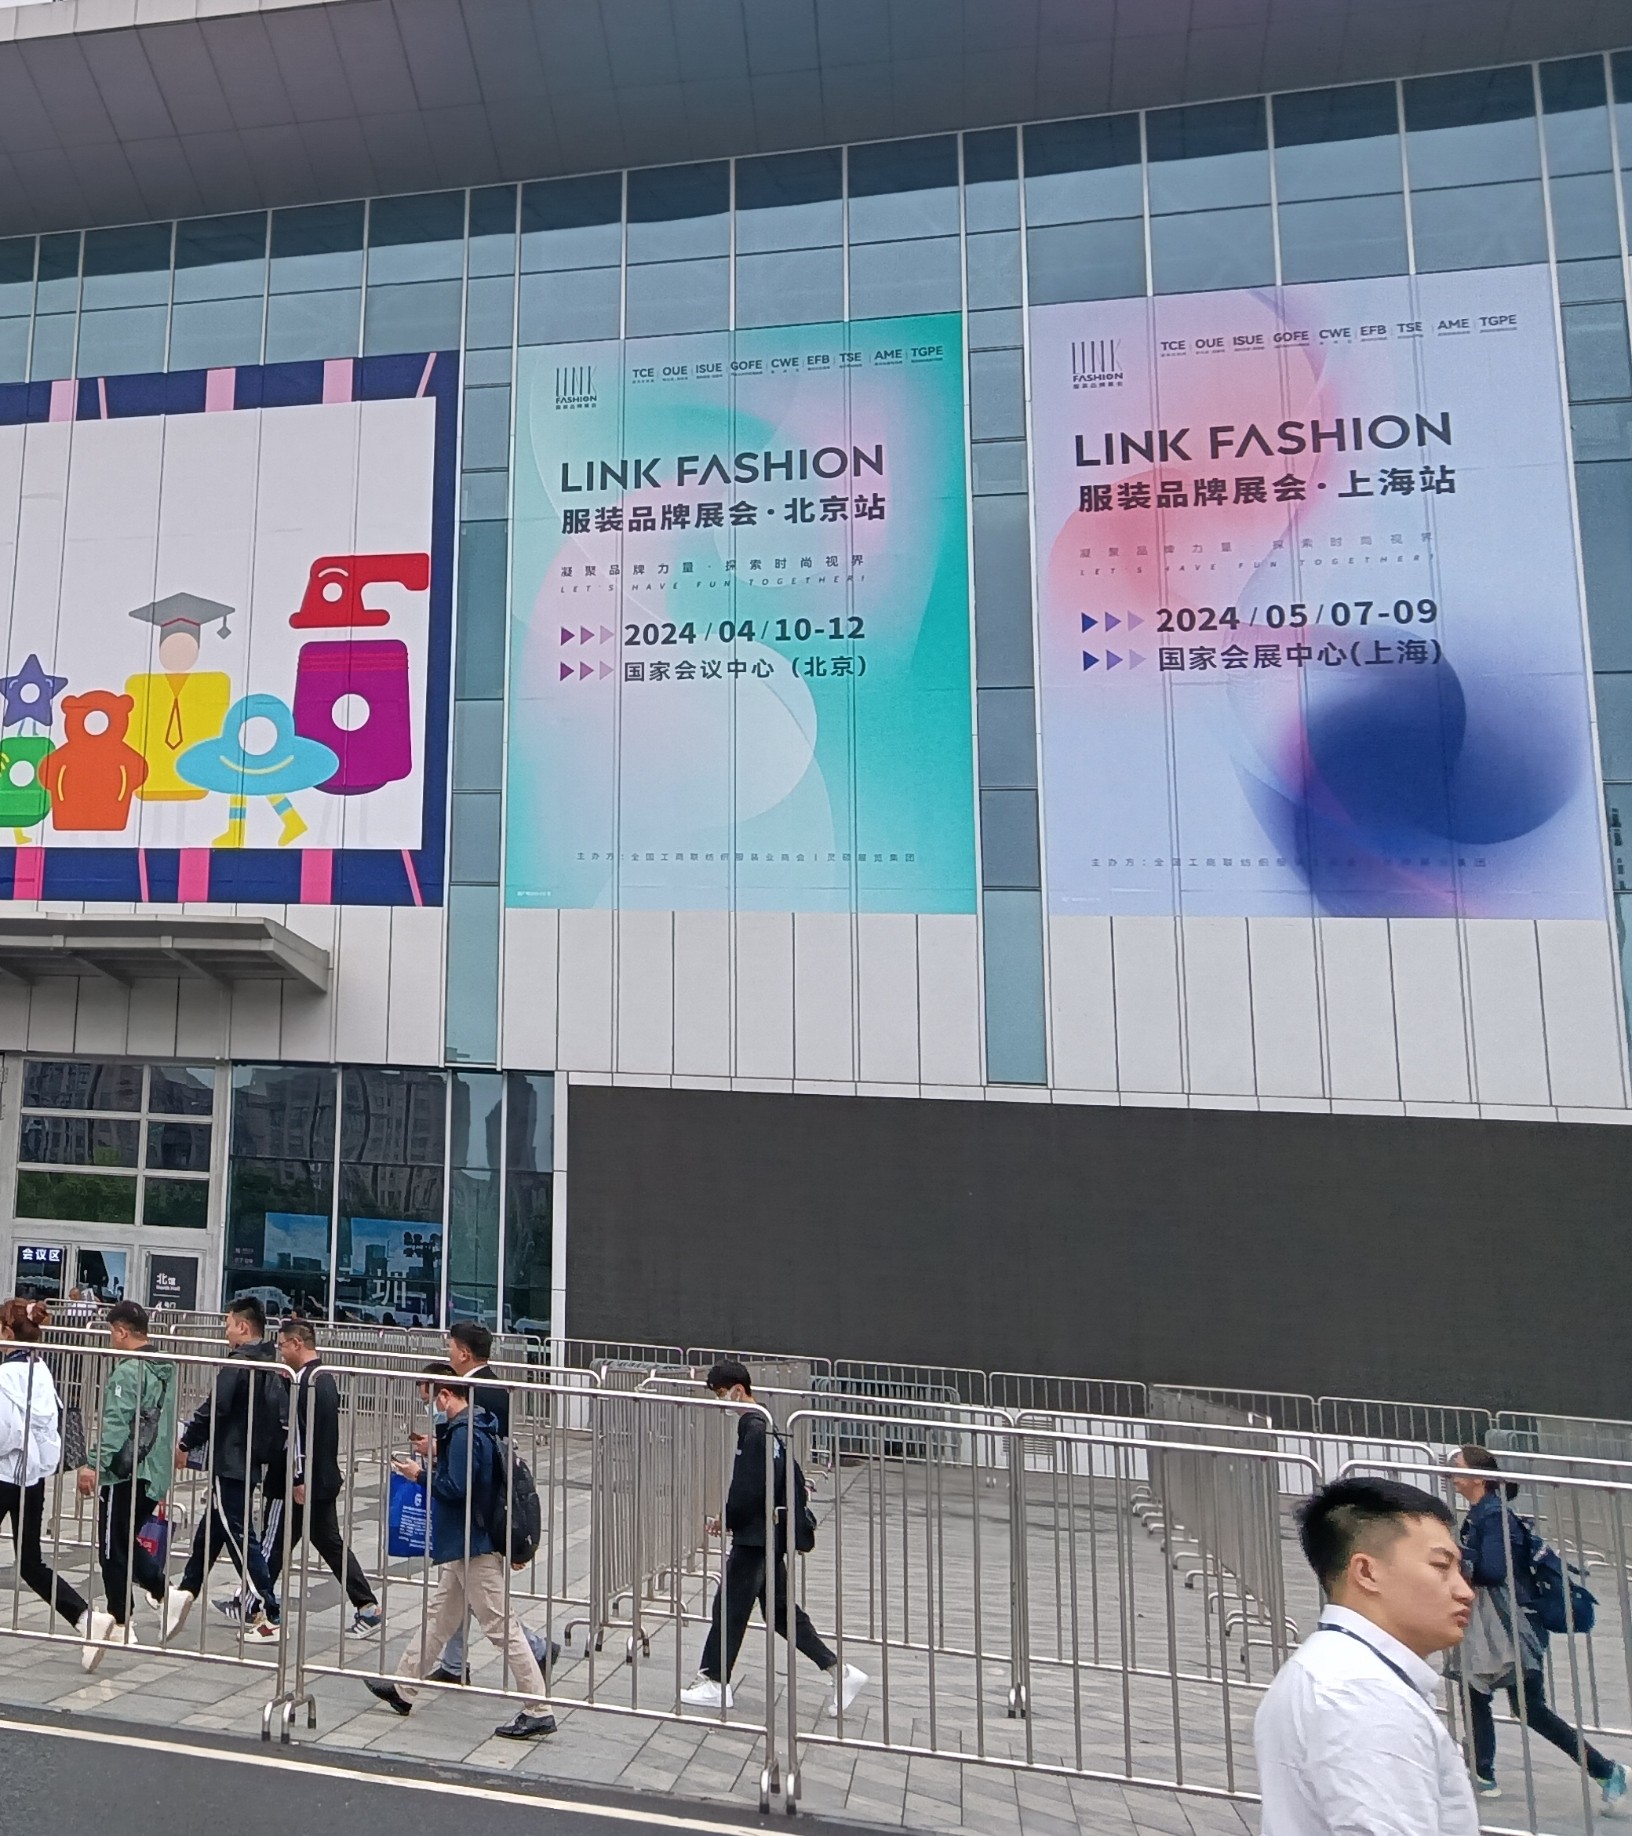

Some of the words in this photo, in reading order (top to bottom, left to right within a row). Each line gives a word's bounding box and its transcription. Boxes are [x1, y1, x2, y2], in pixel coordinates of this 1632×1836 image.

[1160, 340, 1186, 351] TCE
[1195, 337, 1224, 349] OUE
[1233, 334, 1264, 346] ISUE
[1273, 330, 1309, 343] GOFE
[1319, 327, 1351, 339] CWE
[1360, 325, 1387, 336] EFB
[1397, 322, 1423, 333] TSE
[1437, 318, 1469, 330] AME
[1479, 314, 1517, 327] TGPE
[632, 368, 654, 378] TCE
[662, 366, 688, 376] OUE
[695, 363, 723, 374] ISUE
[730, 360, 763, 371] GOFE
[771, 357, 799, 369] CWE
[807, 354, 830, 365] EFB
[839, 352, 862, 363] TSE
[874, 349, 903, 360] AME
[910, 346, 943, 357] TGPE
[1073, 372, 1124, 382] FASHION
[556, 395, 597, 404] FASHION
[1075, 428, 1192, 467] LINK
[1209, 412, 1451, 460] FASHION
[561, 458, 661, 493] LINK
[677, 444, 883, 487] FASHION
[1078, 464, 1456, 513] 服装品牌展会·上海站
[561, 492, 886, 535] 服装品牌展会·北京站
[632, 582, 678, 591] HAVE
[696, 580, 731, 588] FUN
[22, 1248, 60, 1262] 会议区
